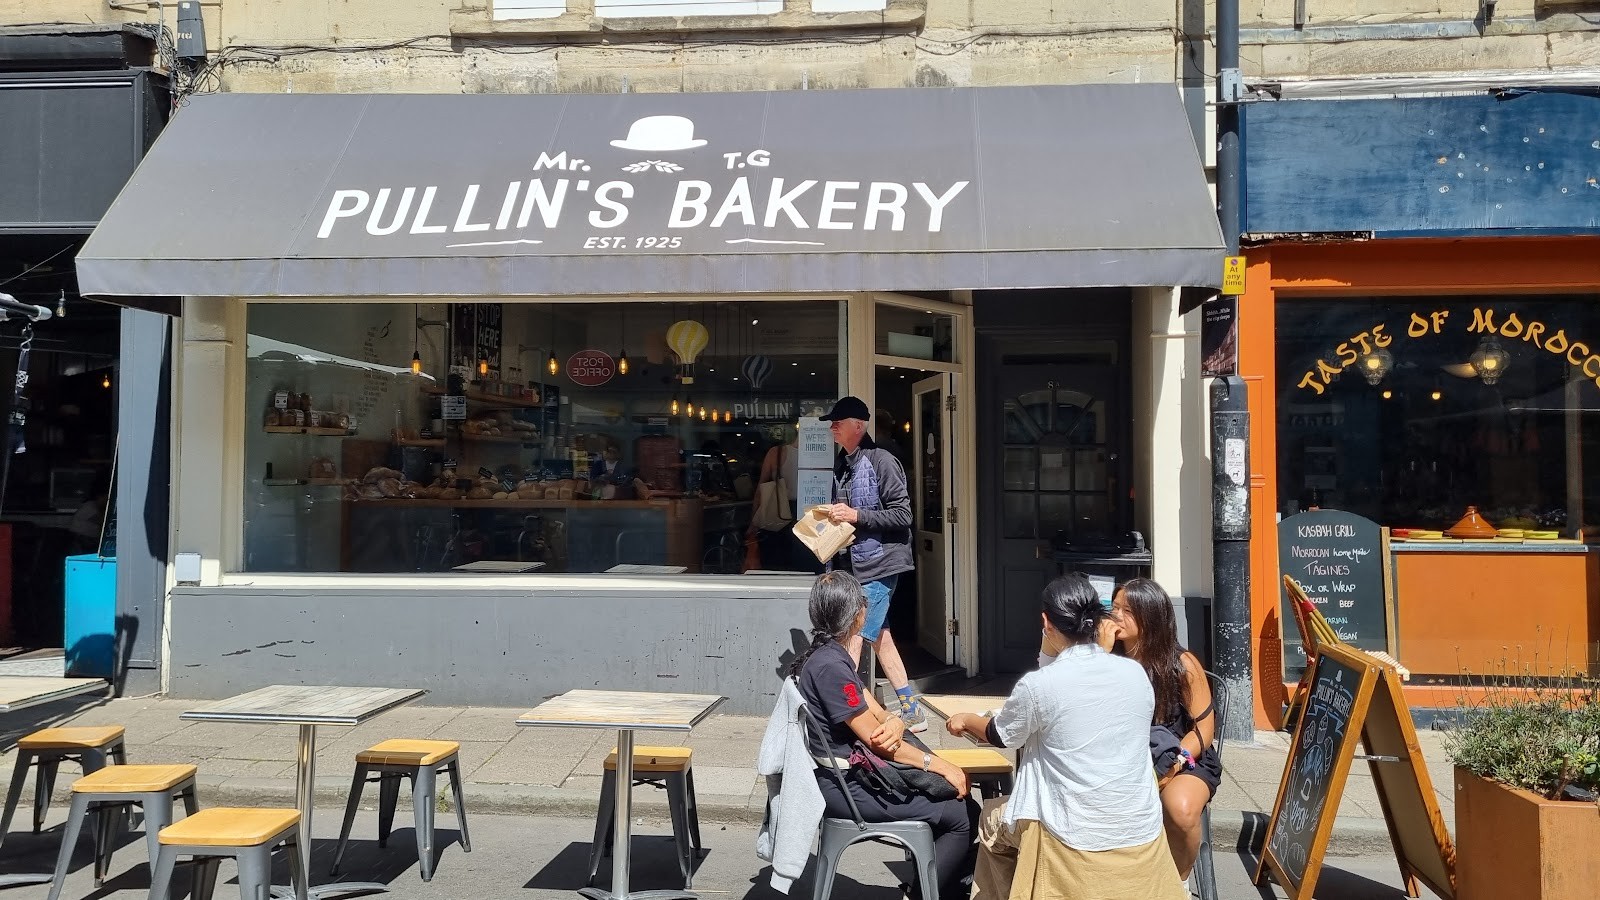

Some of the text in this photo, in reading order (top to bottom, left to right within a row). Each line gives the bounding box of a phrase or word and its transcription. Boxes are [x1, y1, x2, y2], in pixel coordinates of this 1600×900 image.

[532, 150, 591, 172] Mr.
[723, 149, 771, 170] T.G
[316, 176, 970, 240] PULLIN'S BAKERY
[582, 236, 683, 249] EST. 1925
[479, 303, 501, 327] STOP
[478, 325, 500, 349] HERE
[1298, 325, 1392, 395] TASTE
[1407, 310, 1449, 338] OF
[805, 443, 827, 452] HIRING
[1298, 524, 1356, 538] KASBAH GRILL
[1302, 559, 1351, 576] TAGINES
[1317, 585, 1330, 593] OR
[1331, 580, 1356, 593] WRAP
[1339, 599, 1355, 608] BEEF
[1335, 626, 1358, 640] VEGAN
[842, 682, 861, 708] 3
